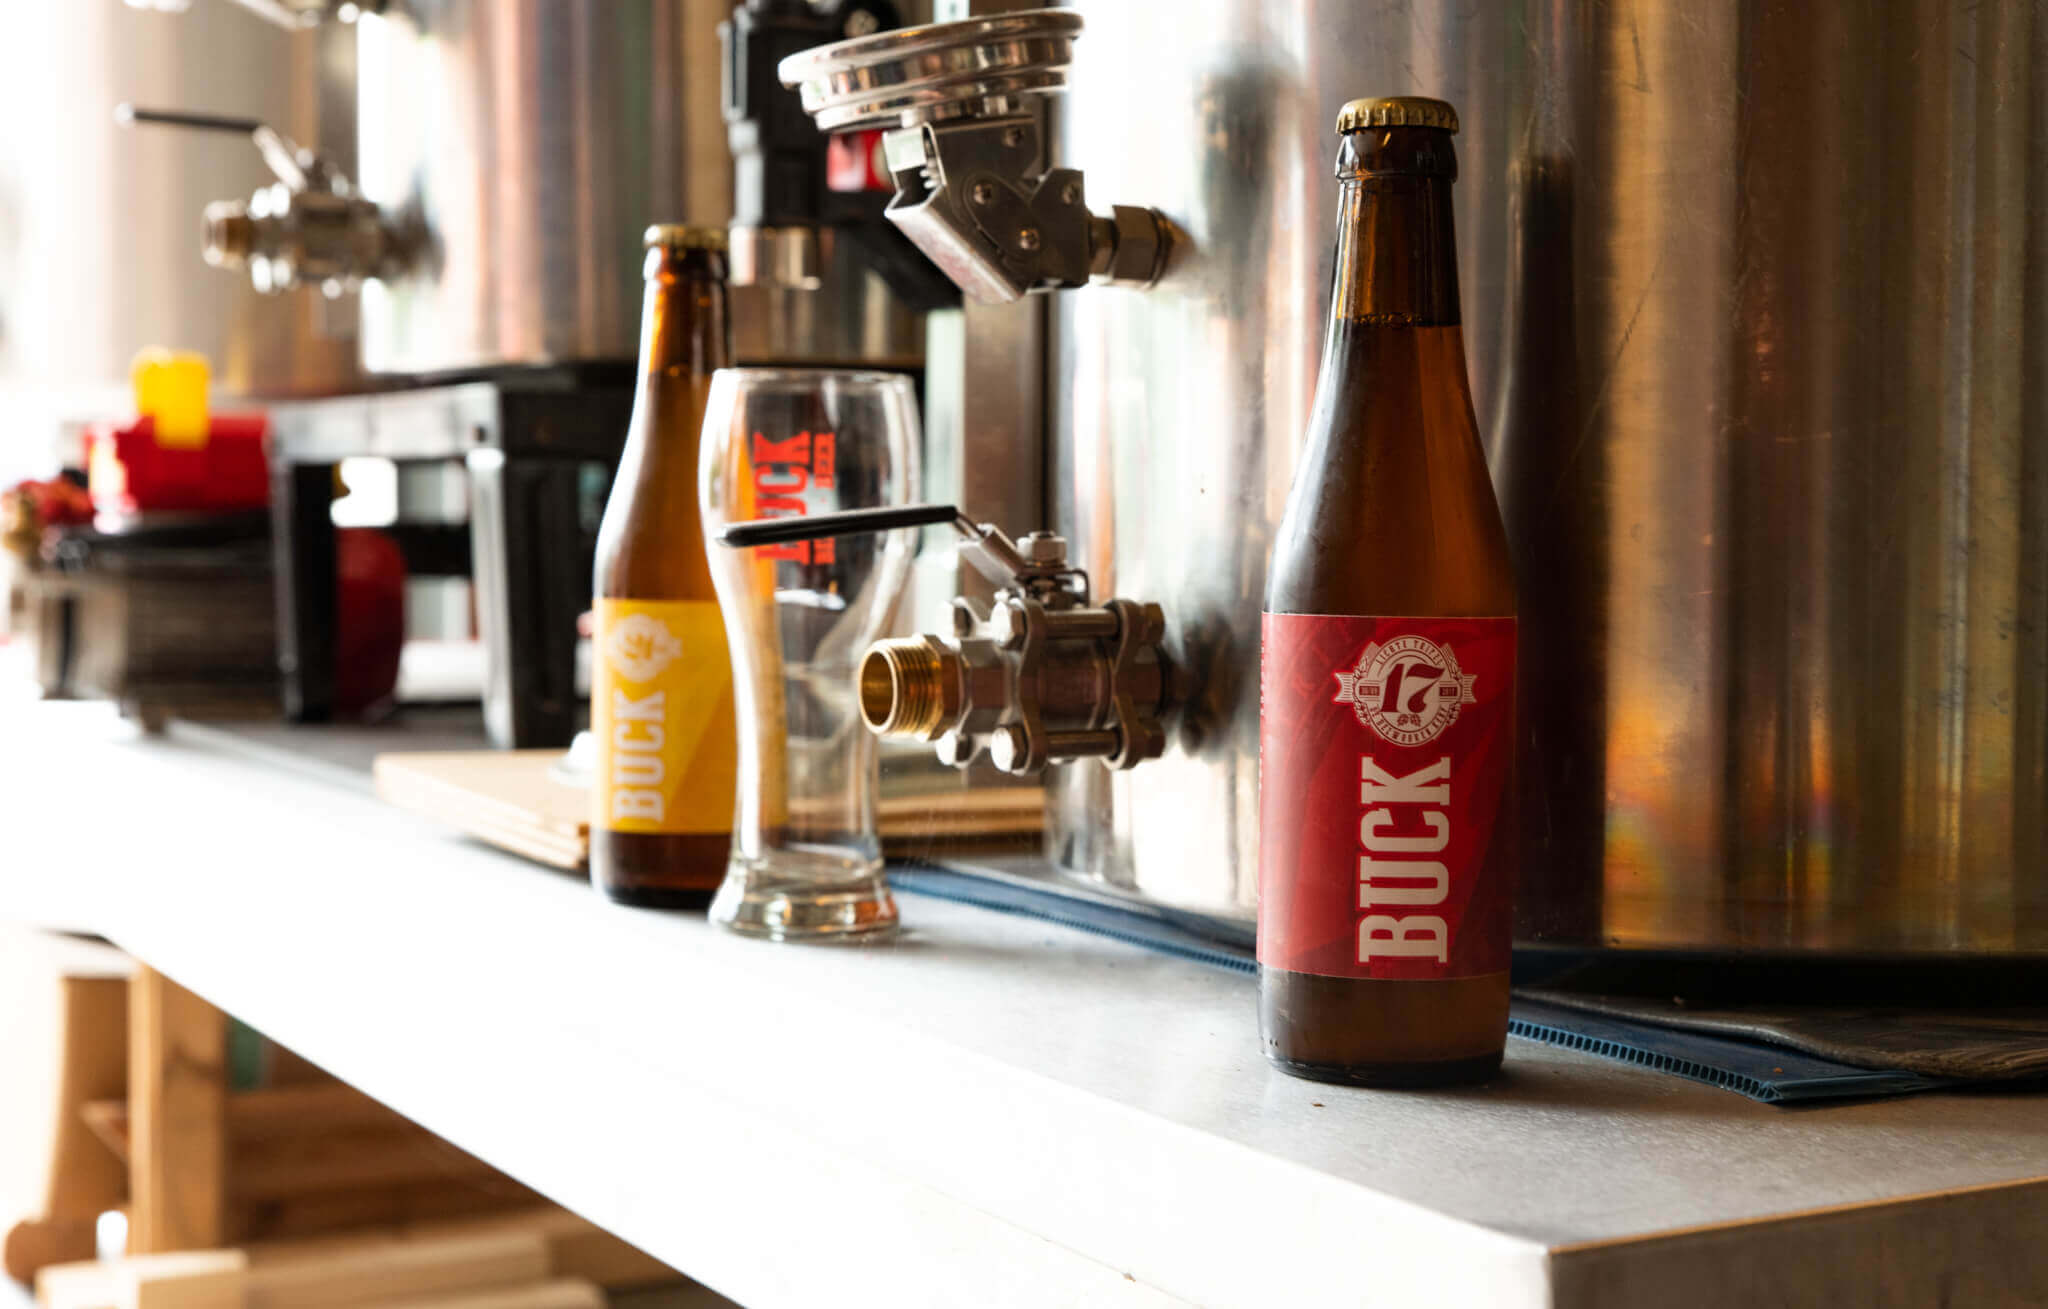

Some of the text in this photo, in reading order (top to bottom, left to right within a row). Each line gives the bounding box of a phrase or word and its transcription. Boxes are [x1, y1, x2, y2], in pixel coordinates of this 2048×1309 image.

[1380, 663, 1446, 713] 17
[613, 689, 665, 822] BUCK
[1358, 756, 1450, 963] BUCK
